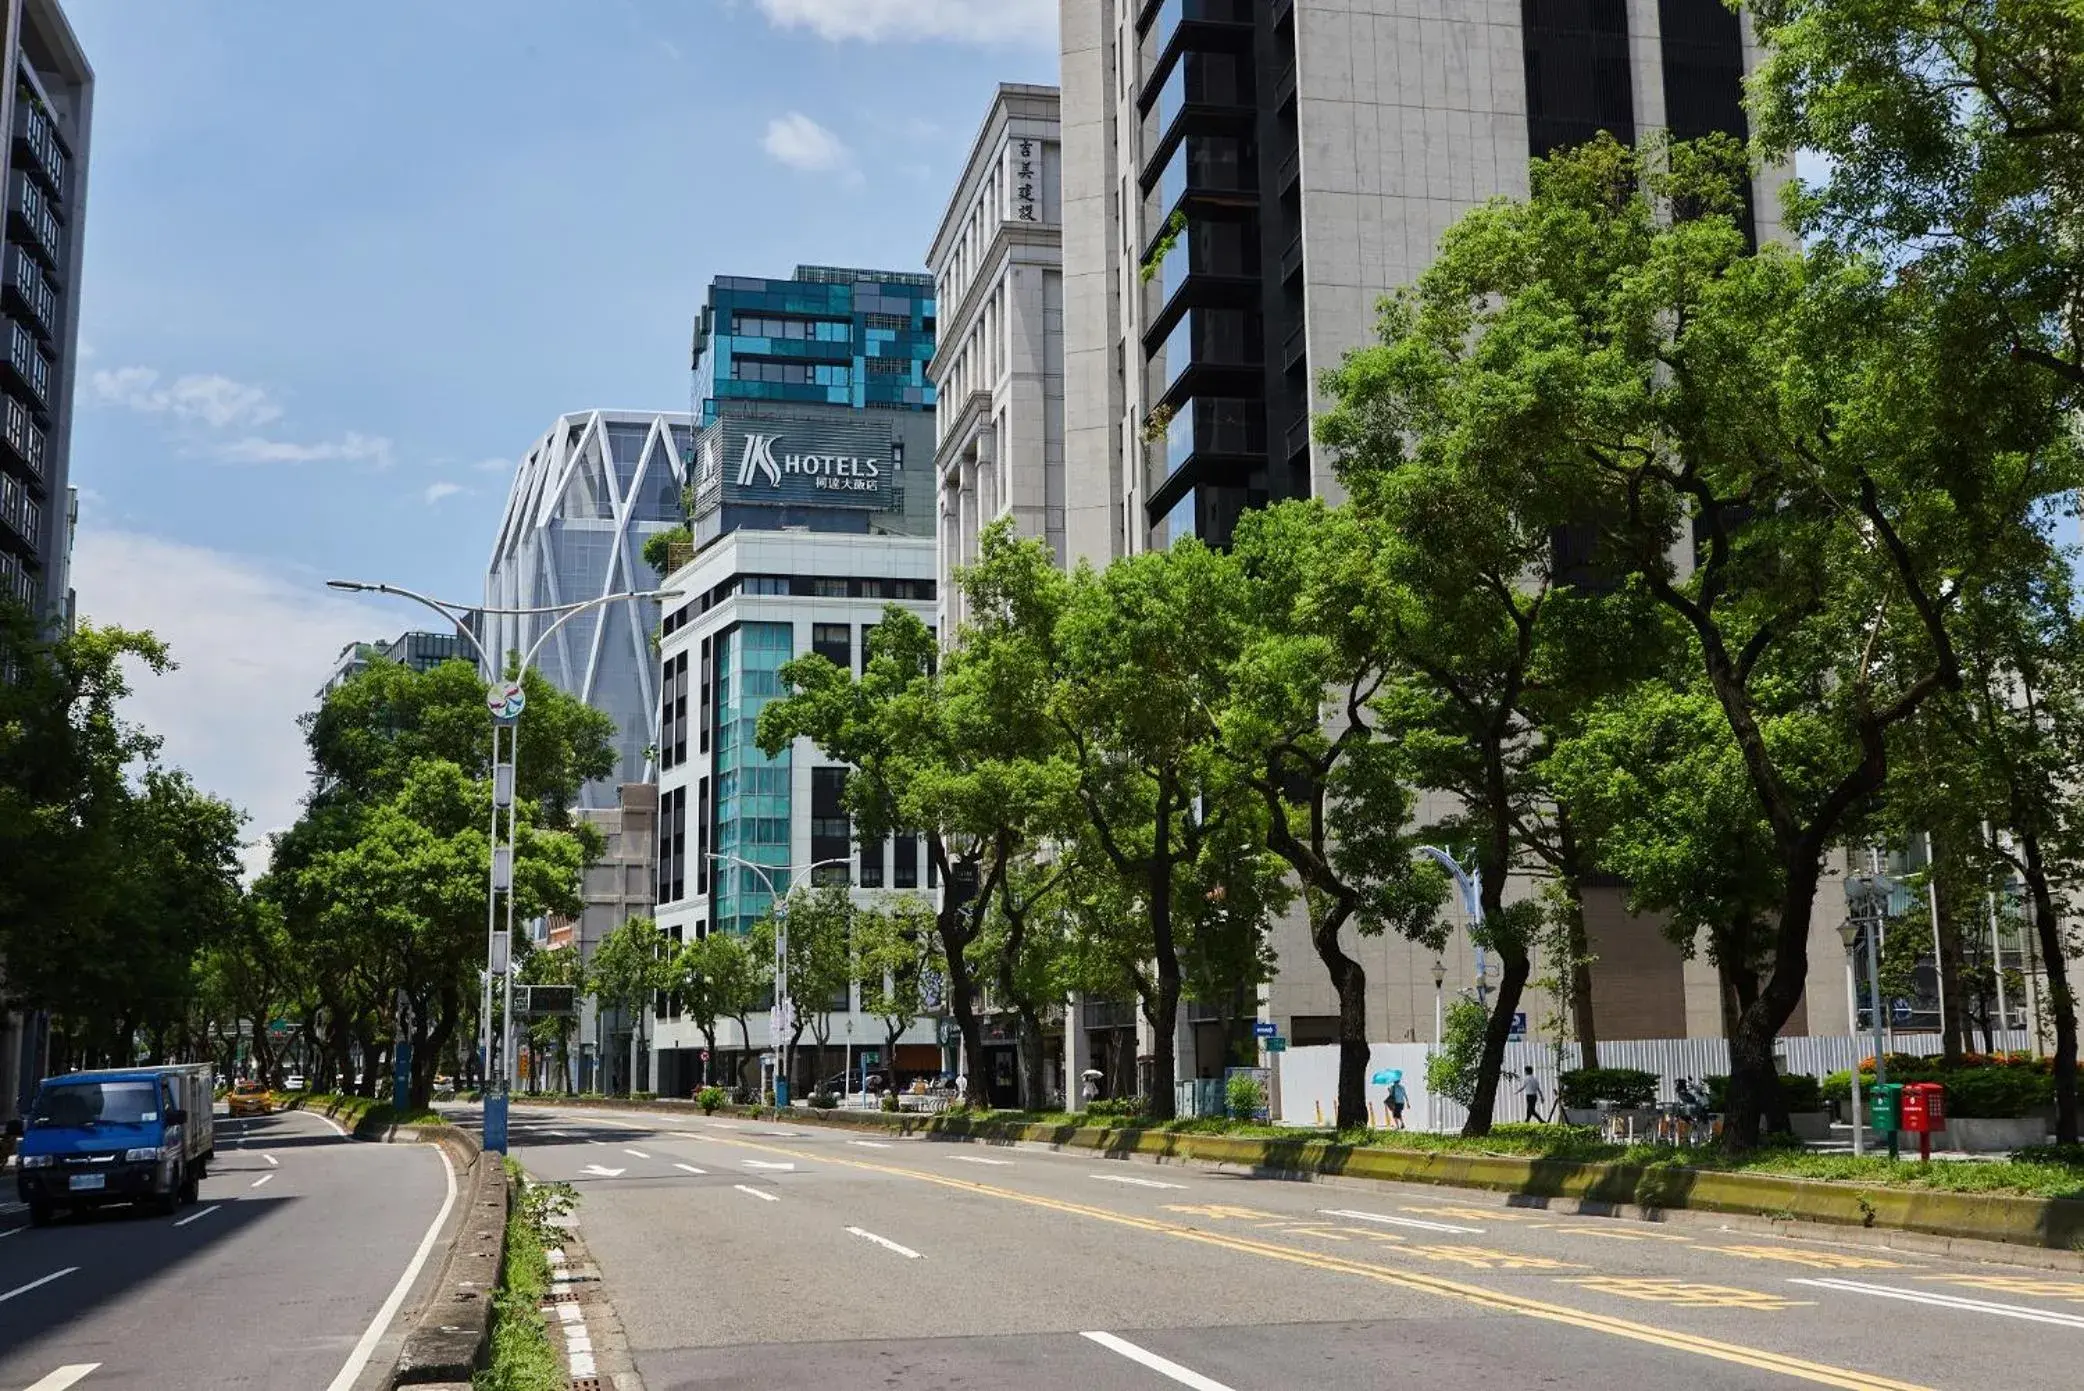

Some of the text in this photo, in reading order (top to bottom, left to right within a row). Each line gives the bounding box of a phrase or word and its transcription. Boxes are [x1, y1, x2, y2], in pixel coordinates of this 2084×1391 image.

[785, 455, 879, 477] HOTELS
[816, 476, 878, 492] 柯達大飯店
